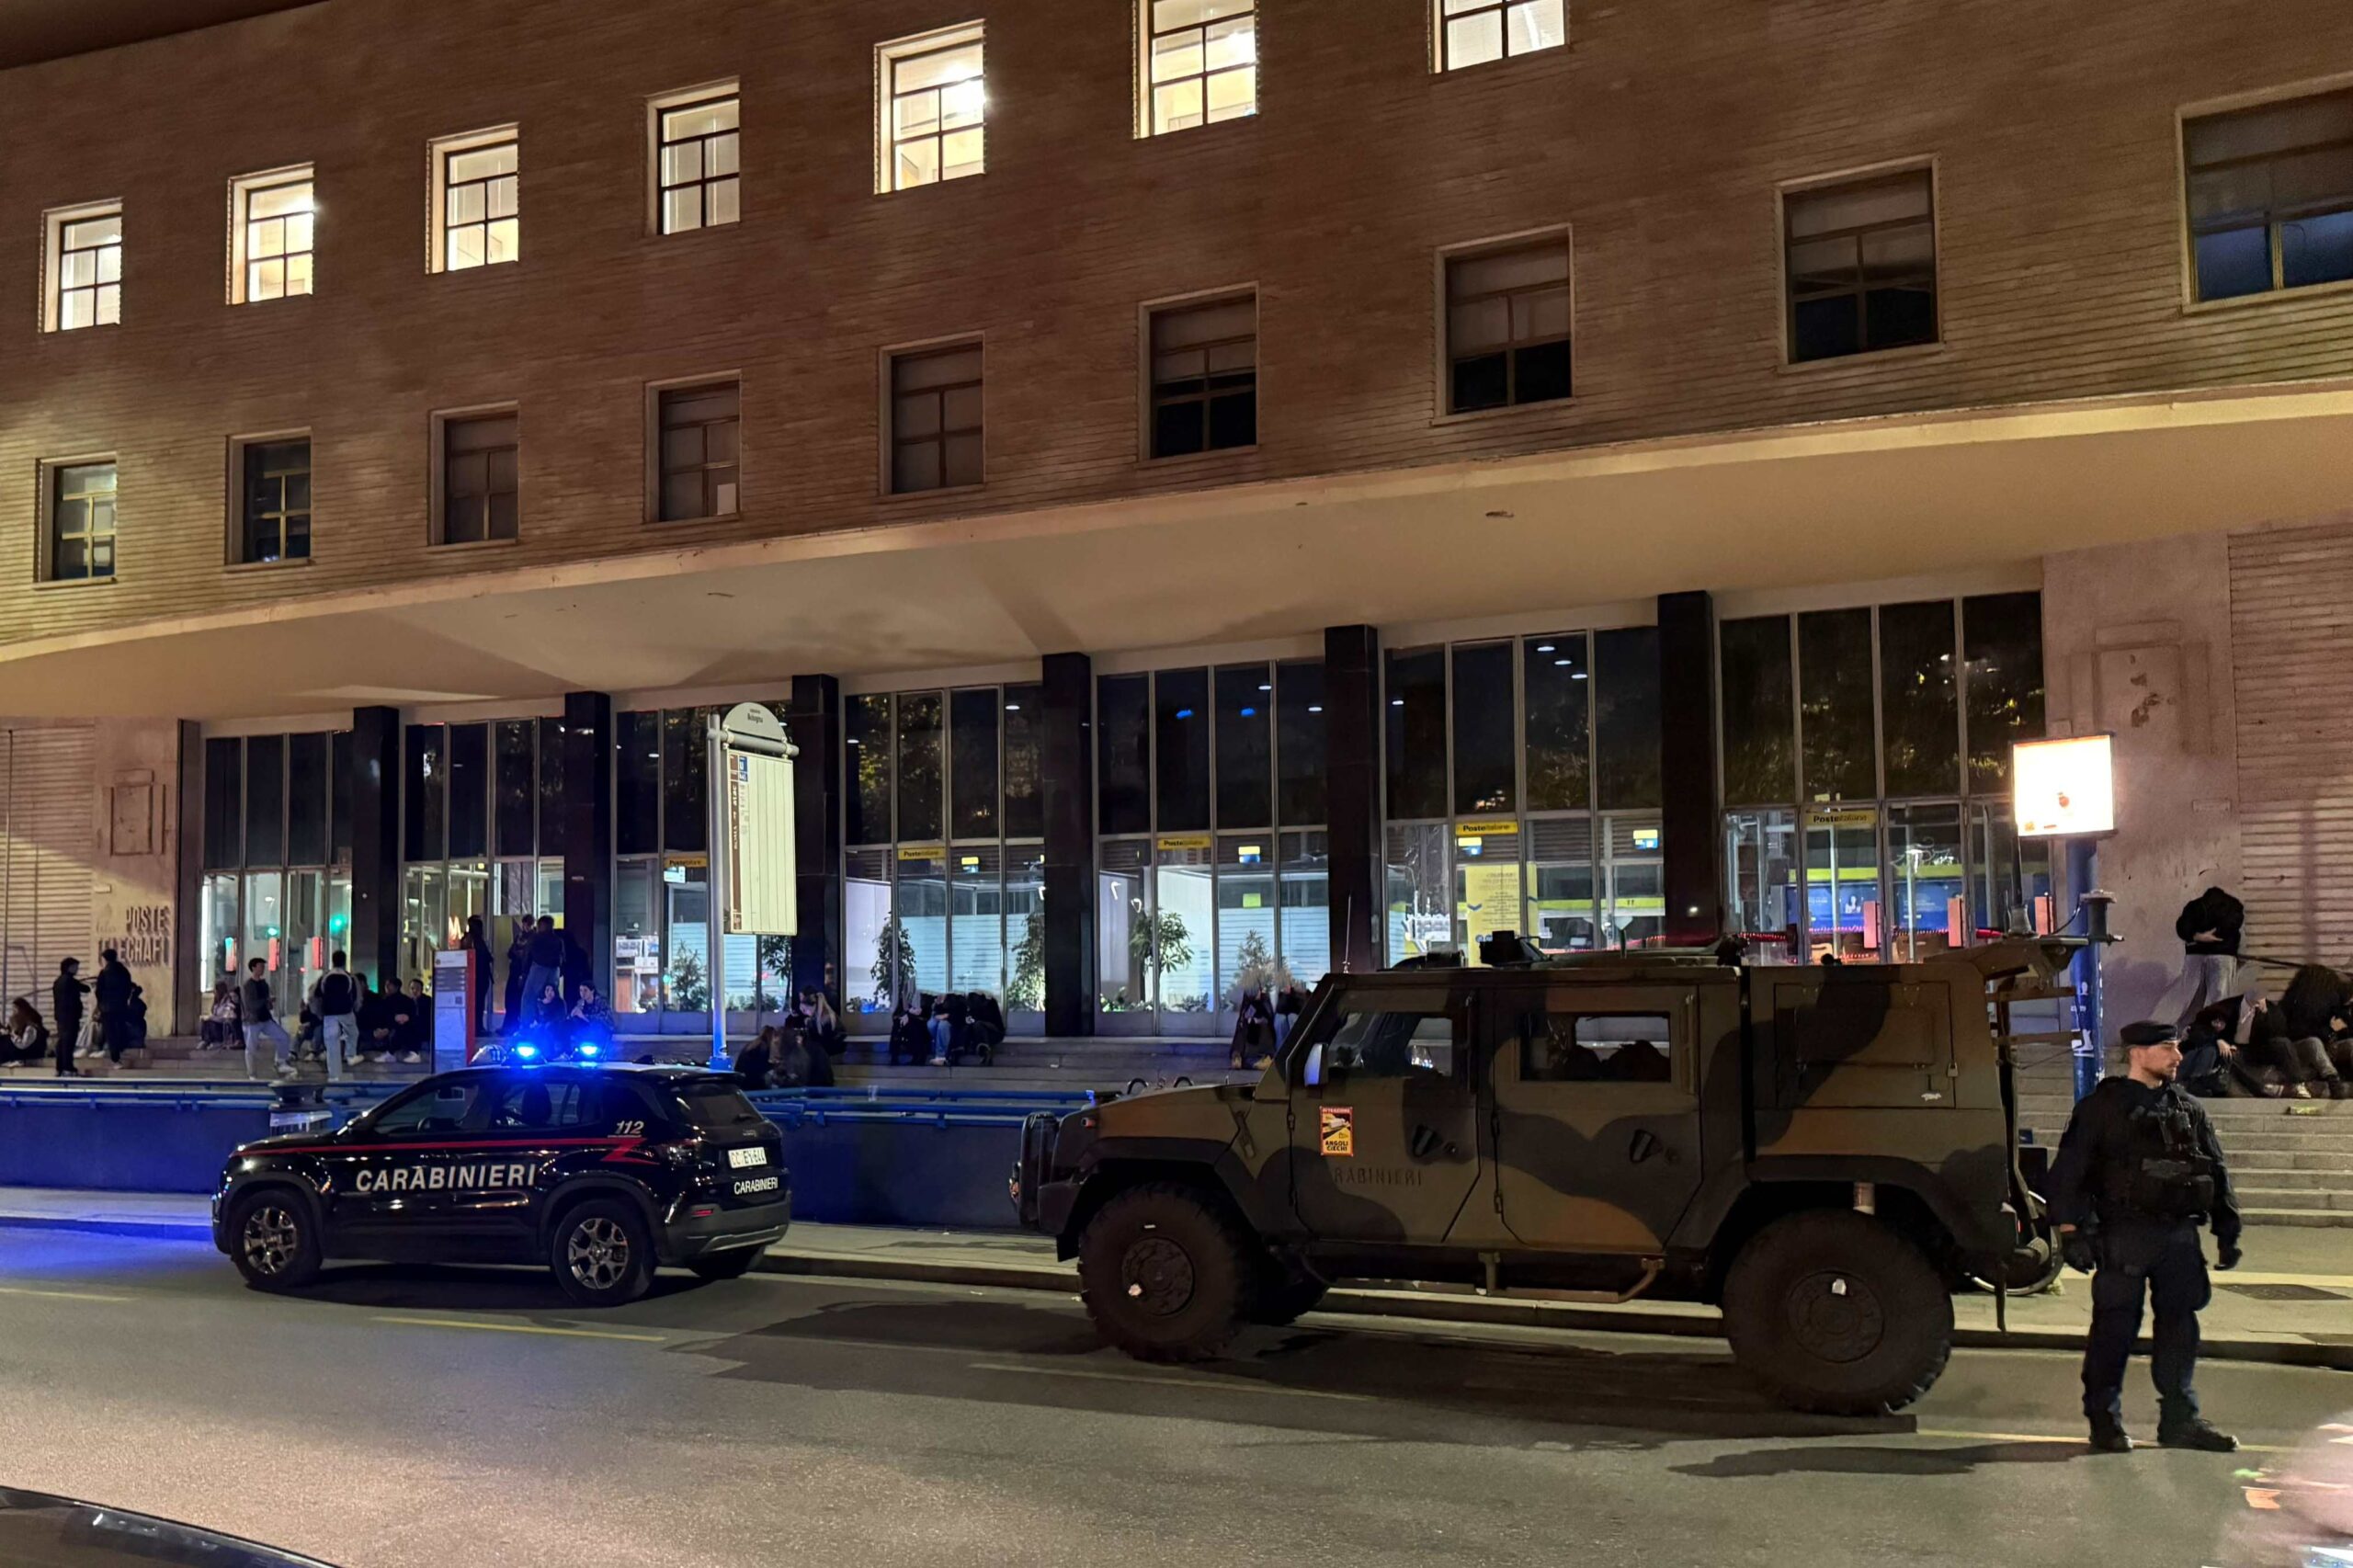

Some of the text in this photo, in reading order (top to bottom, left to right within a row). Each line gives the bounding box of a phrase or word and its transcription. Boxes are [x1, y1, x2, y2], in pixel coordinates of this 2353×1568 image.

[126, 905, 170, 935] POSTE
[615, 1120, 644, 1134] 112
[356, 1164, 536, 1192] CARABINIERI
[733, 1176, 779, 1195] CARABINIERI
